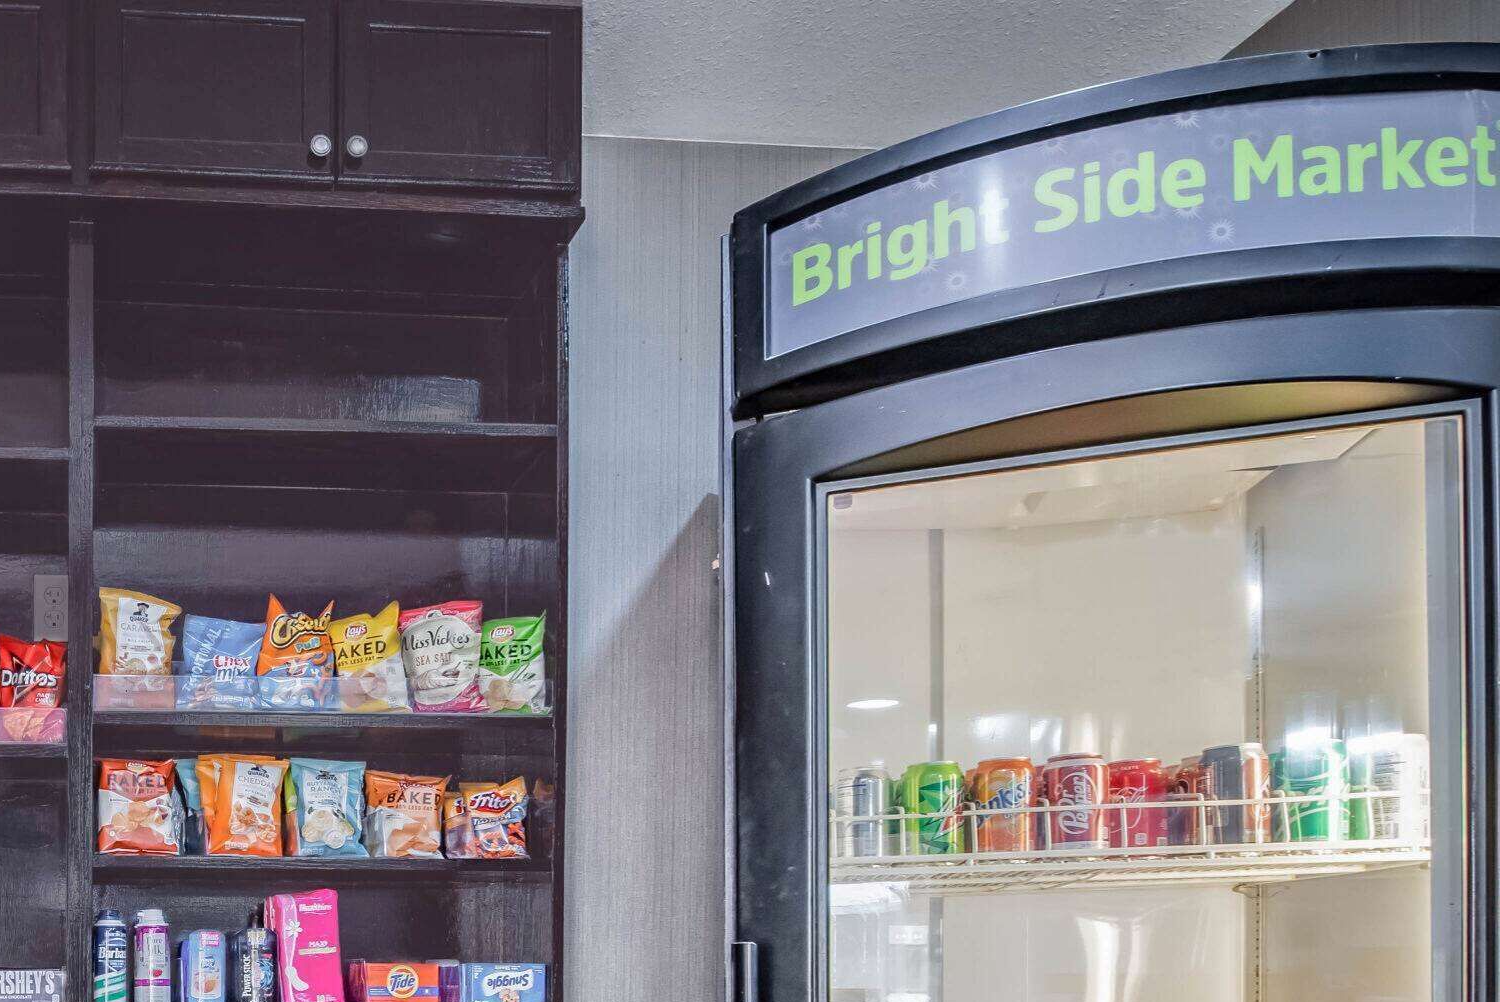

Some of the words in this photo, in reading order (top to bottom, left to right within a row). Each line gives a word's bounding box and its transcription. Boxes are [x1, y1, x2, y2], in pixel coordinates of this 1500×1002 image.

[791, 182, 1009, 306] Bright
[1034, 151, 1204, 233] Side
[1233, 126, 1495, 202] Market
[120, 622, 157, 633] CARAMEL
[345, 624, 368, 640] Lay's
[491, 626, 515, 638] Lay's
[401, 637, 430, 653] Miss
[429, 626, 470, 650] Vickie's
[337, 640, 387, 660] AKED
[213, 654, 251, 668] Chex
[415, 655, 432, 667] SEA
[434, 651, 453, 664] SALT
[0, 669, 58, 687] Doritos
[237, 774, 276, 789] CHEDDAR
[247, 770, 270, 779] QUAKER
[386, 791, 441, 804] BAKED
[97, 947, 127, 960] Barbas
[390, 973, 416, 991] Tide
[486, 972, 530, 989] Snuggle
